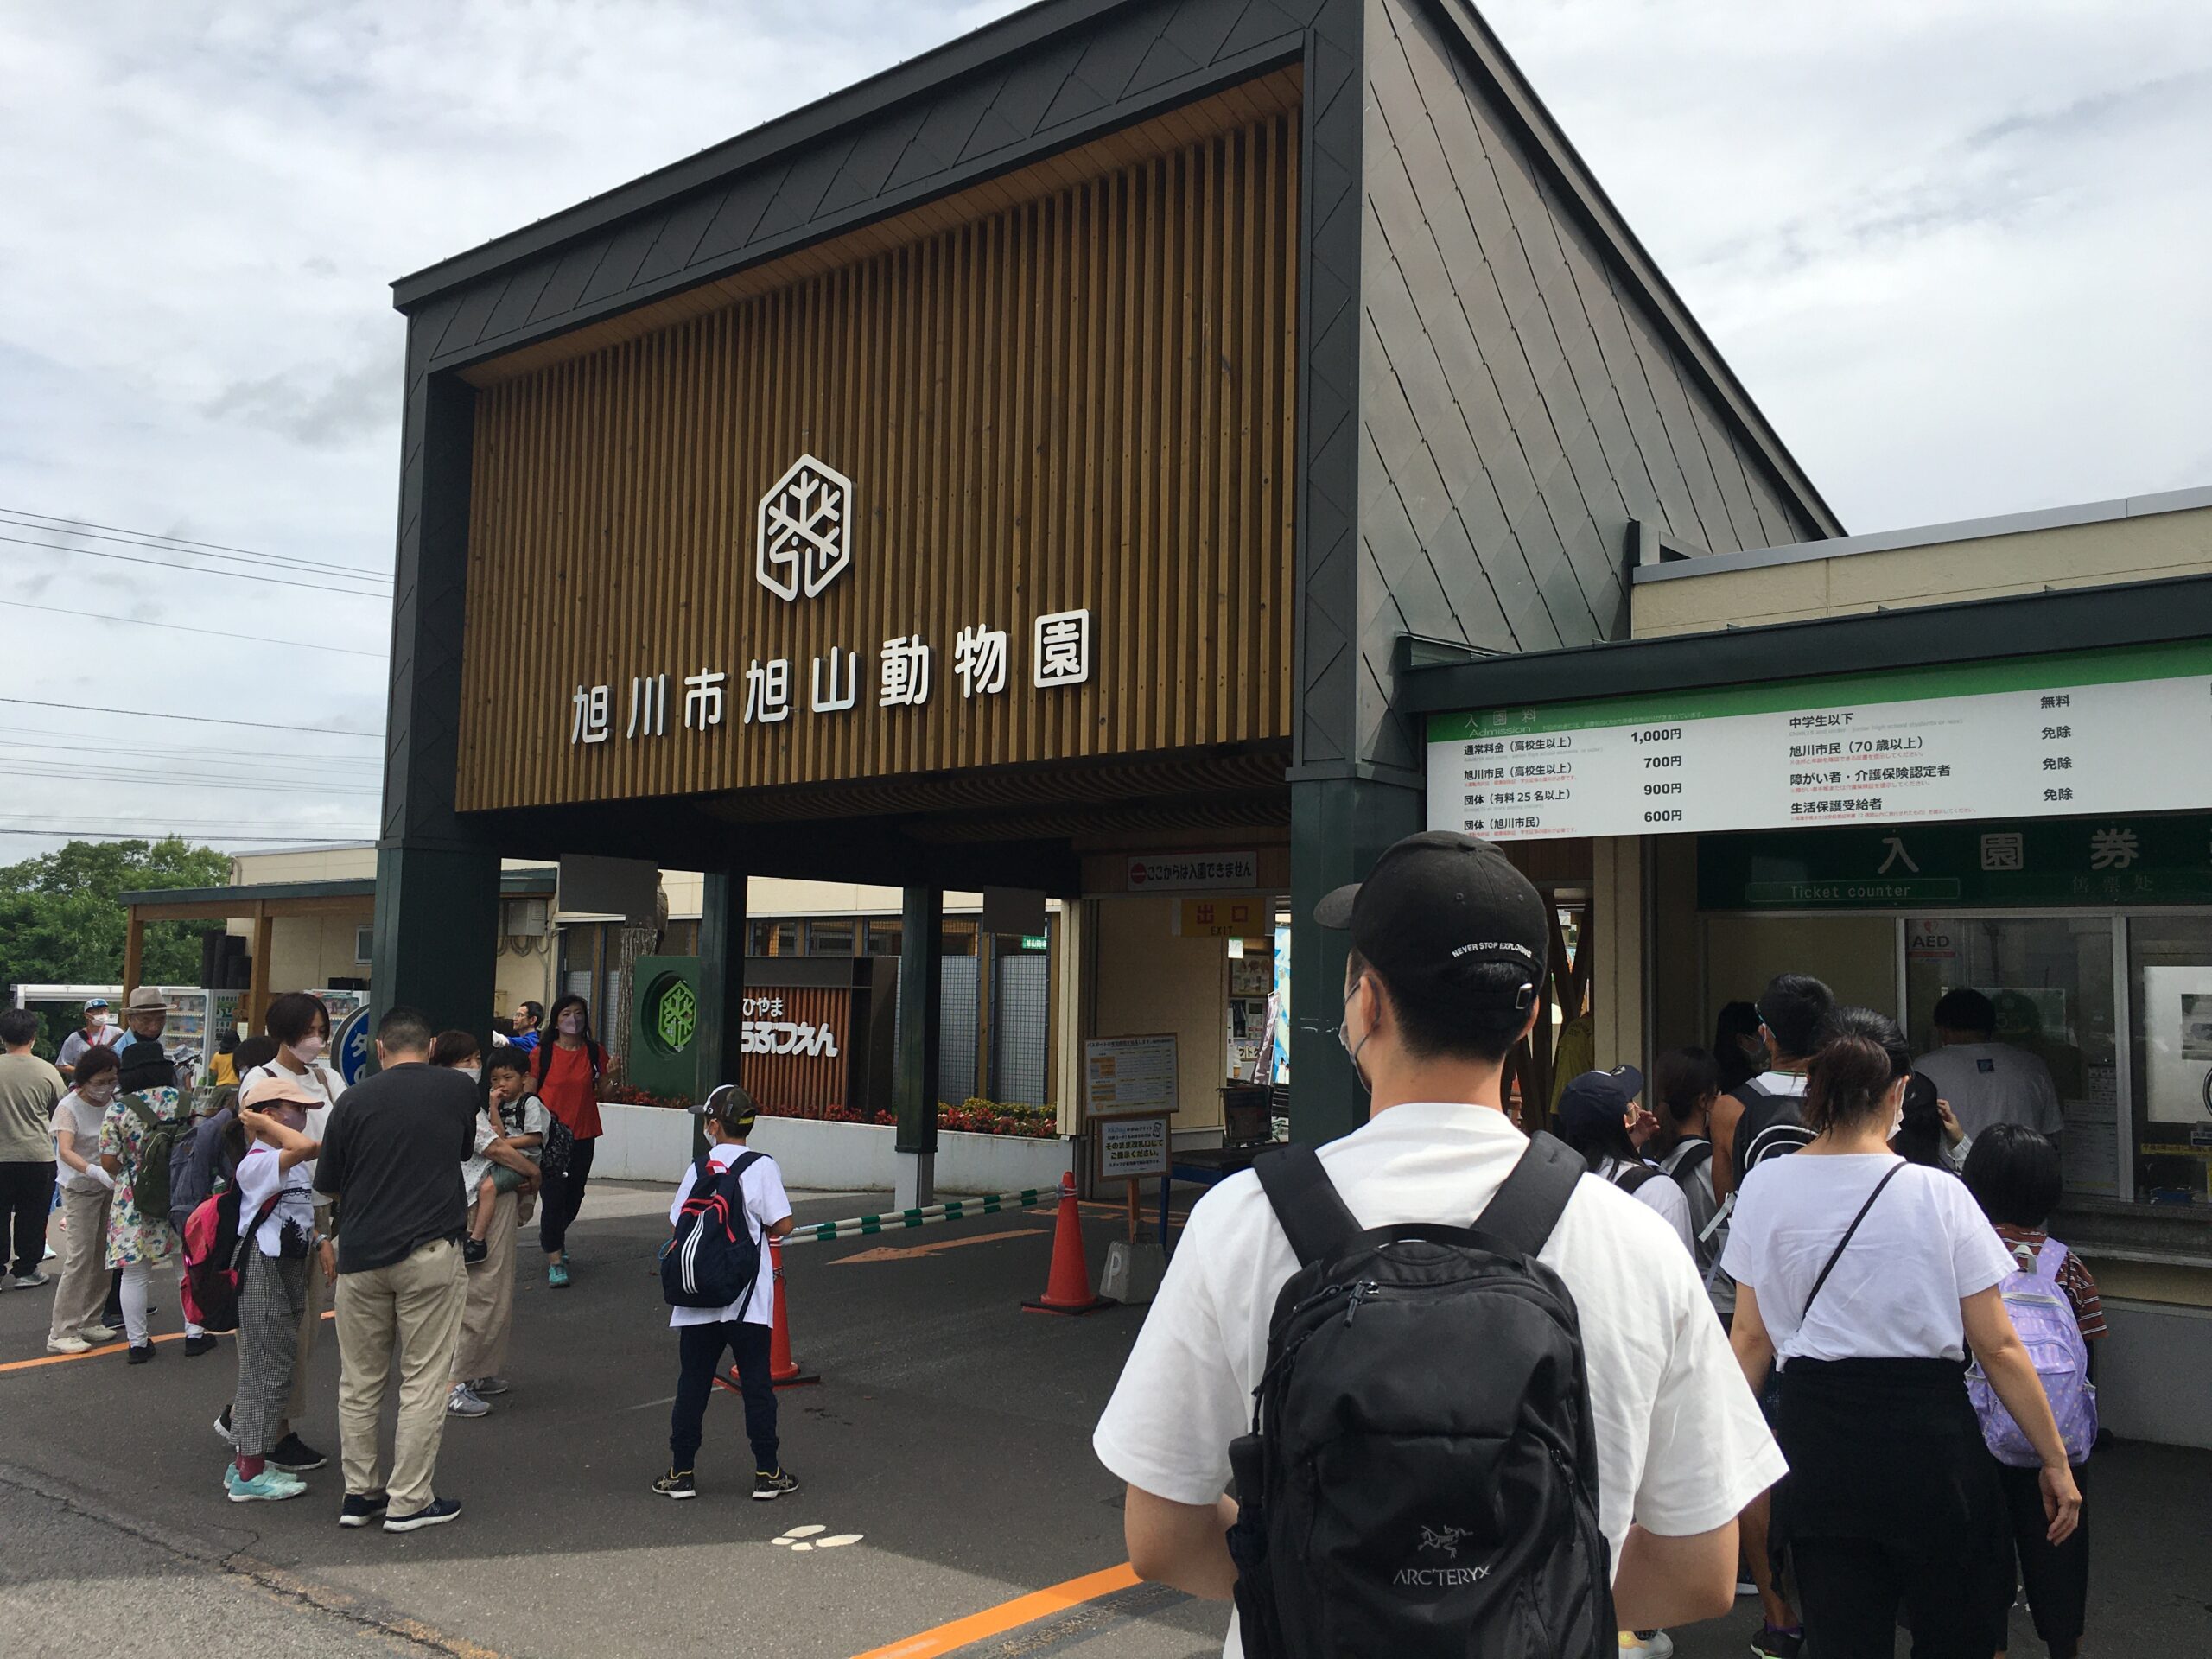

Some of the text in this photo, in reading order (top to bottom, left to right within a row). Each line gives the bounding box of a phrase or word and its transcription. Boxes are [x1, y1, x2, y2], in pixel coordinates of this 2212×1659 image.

[571, 608, 1090, 745] 旭川市旭山動物園
[2040, 694, 2071, 709] 無料
[1789, 713, 1854, 729] 中学生以下
[1469, 725, 1531, 738] Admission
[1630, 728, 1681, 744] 1,000円
[2041, 725, 2072, 740] 免除
[1643, 755, 1681, 769] 700円
[2042, 756, 2073, 771] 免除
[1789, 764, 1951, 786] 障がい者・介護保険認定者
[1643, 782, 1682, 796] 900円
[2043, 787, 2074, 802] 免除
[1790, 798, 1883, 815] 生活保護受給者
[1643, 810, 1682, 823] 600円
[1147, 862, 1252, 880] ここからは入園できません
[1789, 883, 1911, 899] Ticket counter
[1197, 905, 1249, 925] 出口
[1211, 926, 1234, 936] EXIT
[1912, 935, 1950, 948] AED
[1452, 944, 1478, 958] NEVER
[1499, 942, 1532, 958] EXPLORING
